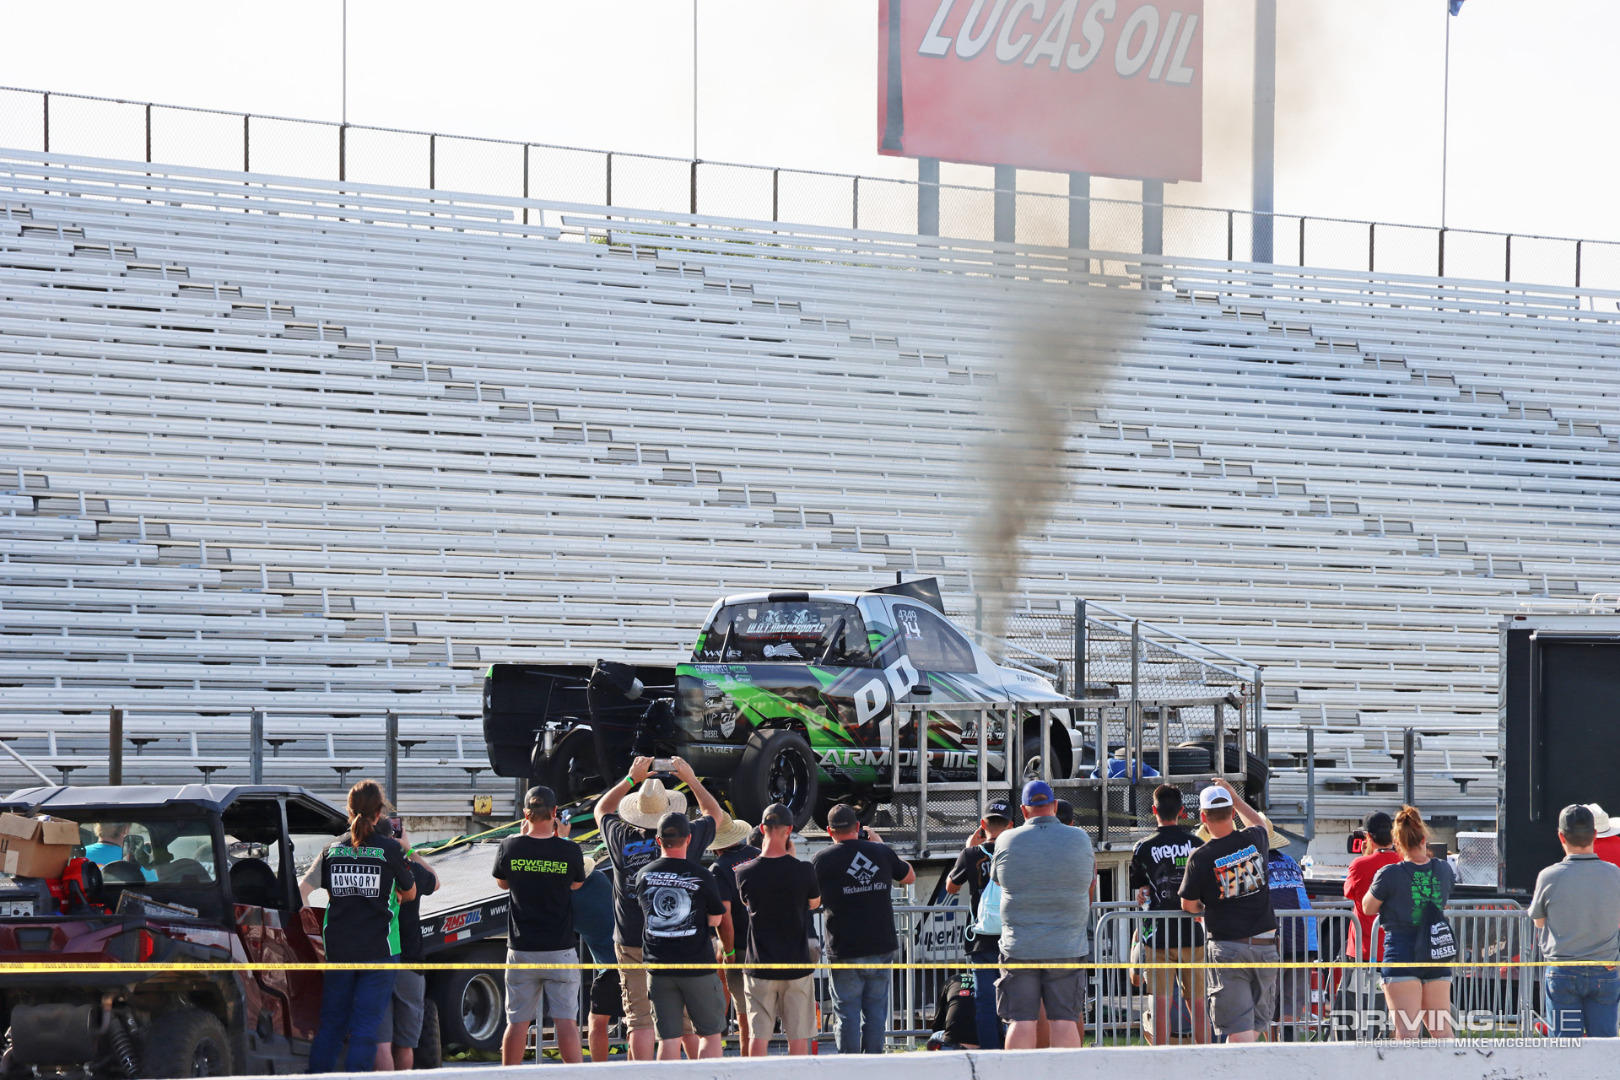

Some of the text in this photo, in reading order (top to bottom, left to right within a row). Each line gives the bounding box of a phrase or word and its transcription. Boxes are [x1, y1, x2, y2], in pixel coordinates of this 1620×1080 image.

[918, 0, 1199, 86] LUCAS OIL
[898, 609, 917, 622] 4349
[902, 621, 921, 637] 14
[819, 748, 934, 767] ARMOR
[510, 859, 568, 869] POWERED
[524, 865, 568, 874] SCIENCE
[334, 875, 377, 887] ADVISORY
[843, 884, 872, 894] Mechanical
[441, 908, 482, 933] AMSOIL
[1431, 944, 1457, 956] DIESEL
